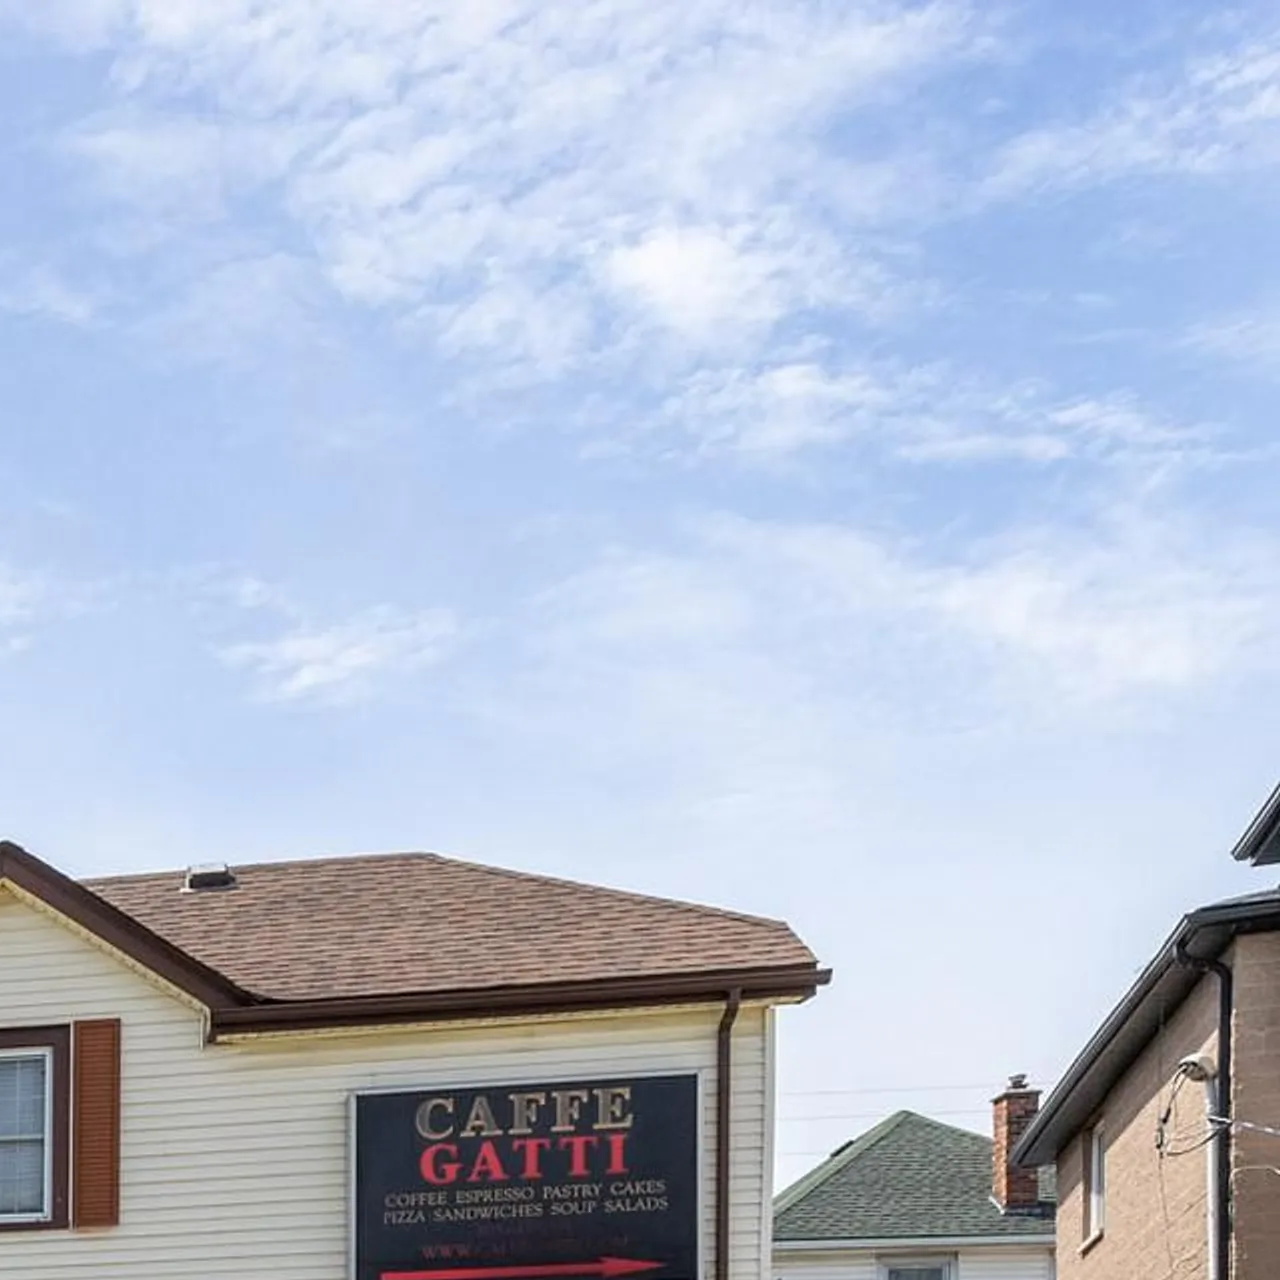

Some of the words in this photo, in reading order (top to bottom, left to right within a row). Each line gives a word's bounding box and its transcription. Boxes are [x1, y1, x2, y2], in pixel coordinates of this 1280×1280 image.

[415, 1086, 634, 1140] CAFFE
[419, 1133, 629, 1185] GATTI
[383, 1209, 426, 1225] PIZZA
[433, 1203, 544, 1222] SANDWICHES
[551, 1200, 598, 1216] SOUP
[604, 1196, 669, 1213] SALADS
[384, 1191, 448, 1208] COFFEE
[455, 1186, 535, 1204] ESPRESSO
[543, 1183, 603, 1200] PASTRY
[610, 1179, 667, 1195] CAKES
